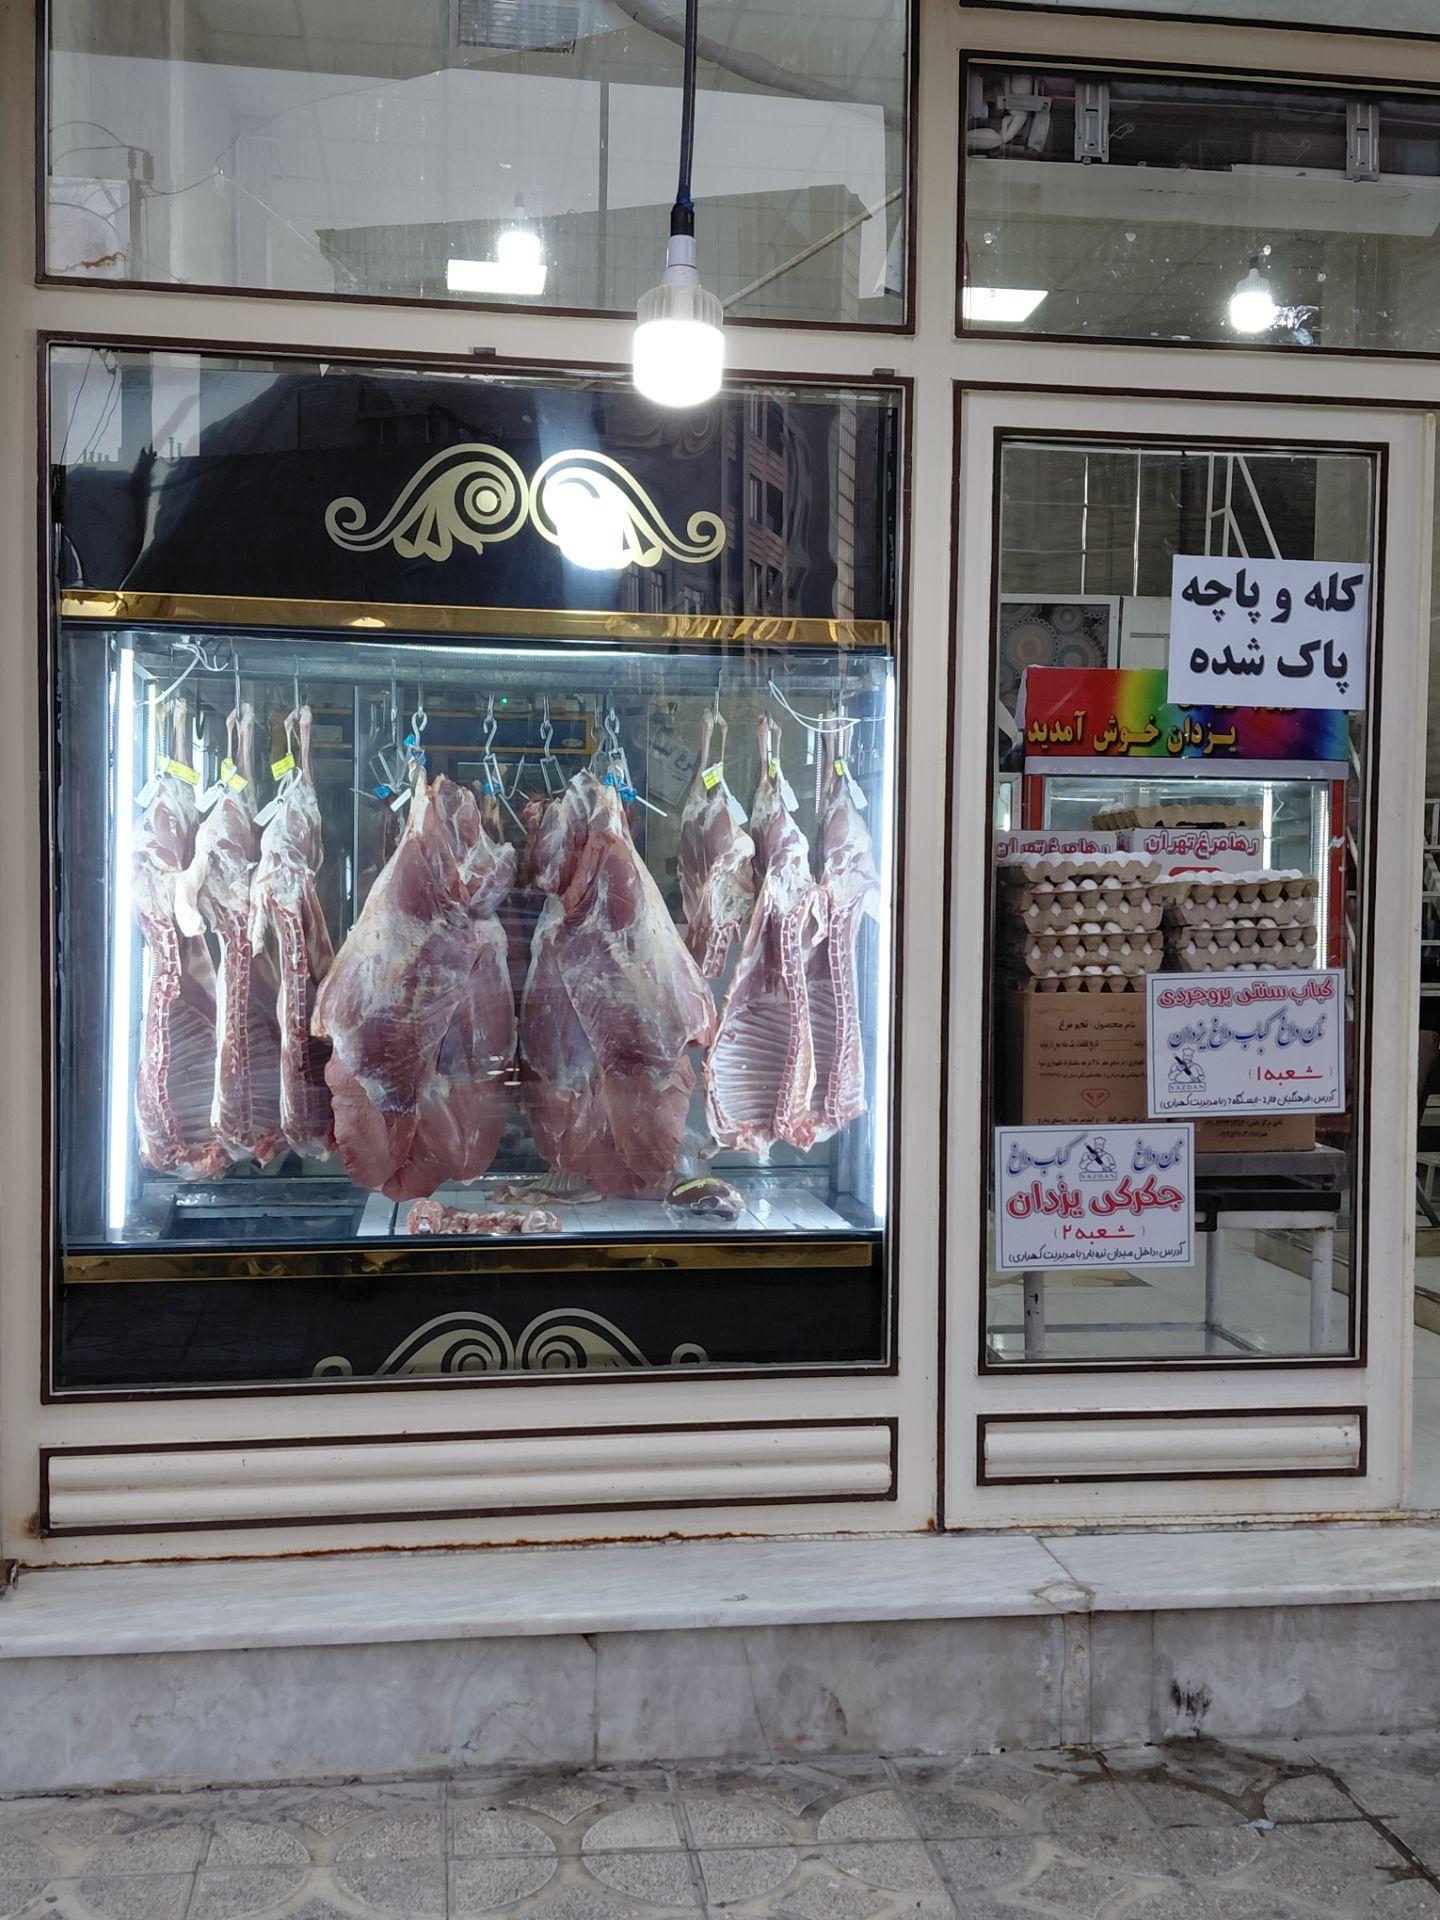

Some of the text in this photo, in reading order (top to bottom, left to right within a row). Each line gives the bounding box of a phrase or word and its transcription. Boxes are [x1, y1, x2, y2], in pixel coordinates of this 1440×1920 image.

[1181, 567, 1364, 624] کله و پاچه
[1189, 636, 1350, 695] پاک شده
[1026, 710, 1237, 754] یزدان خوش آمدید
[1157, 976, 1336, 1008] کباب سنتی بروجردی
[1168, 1006, 1328, 1055] نان داغ کباب داغ یزدان
[1007, 1142, 1033, 1177] داغ
[1131, 1139, 1157, 1173] داغ
[1157, 1138, 1184, 1170] نان
[1006, 1180, 1085, 1218] یزدان
